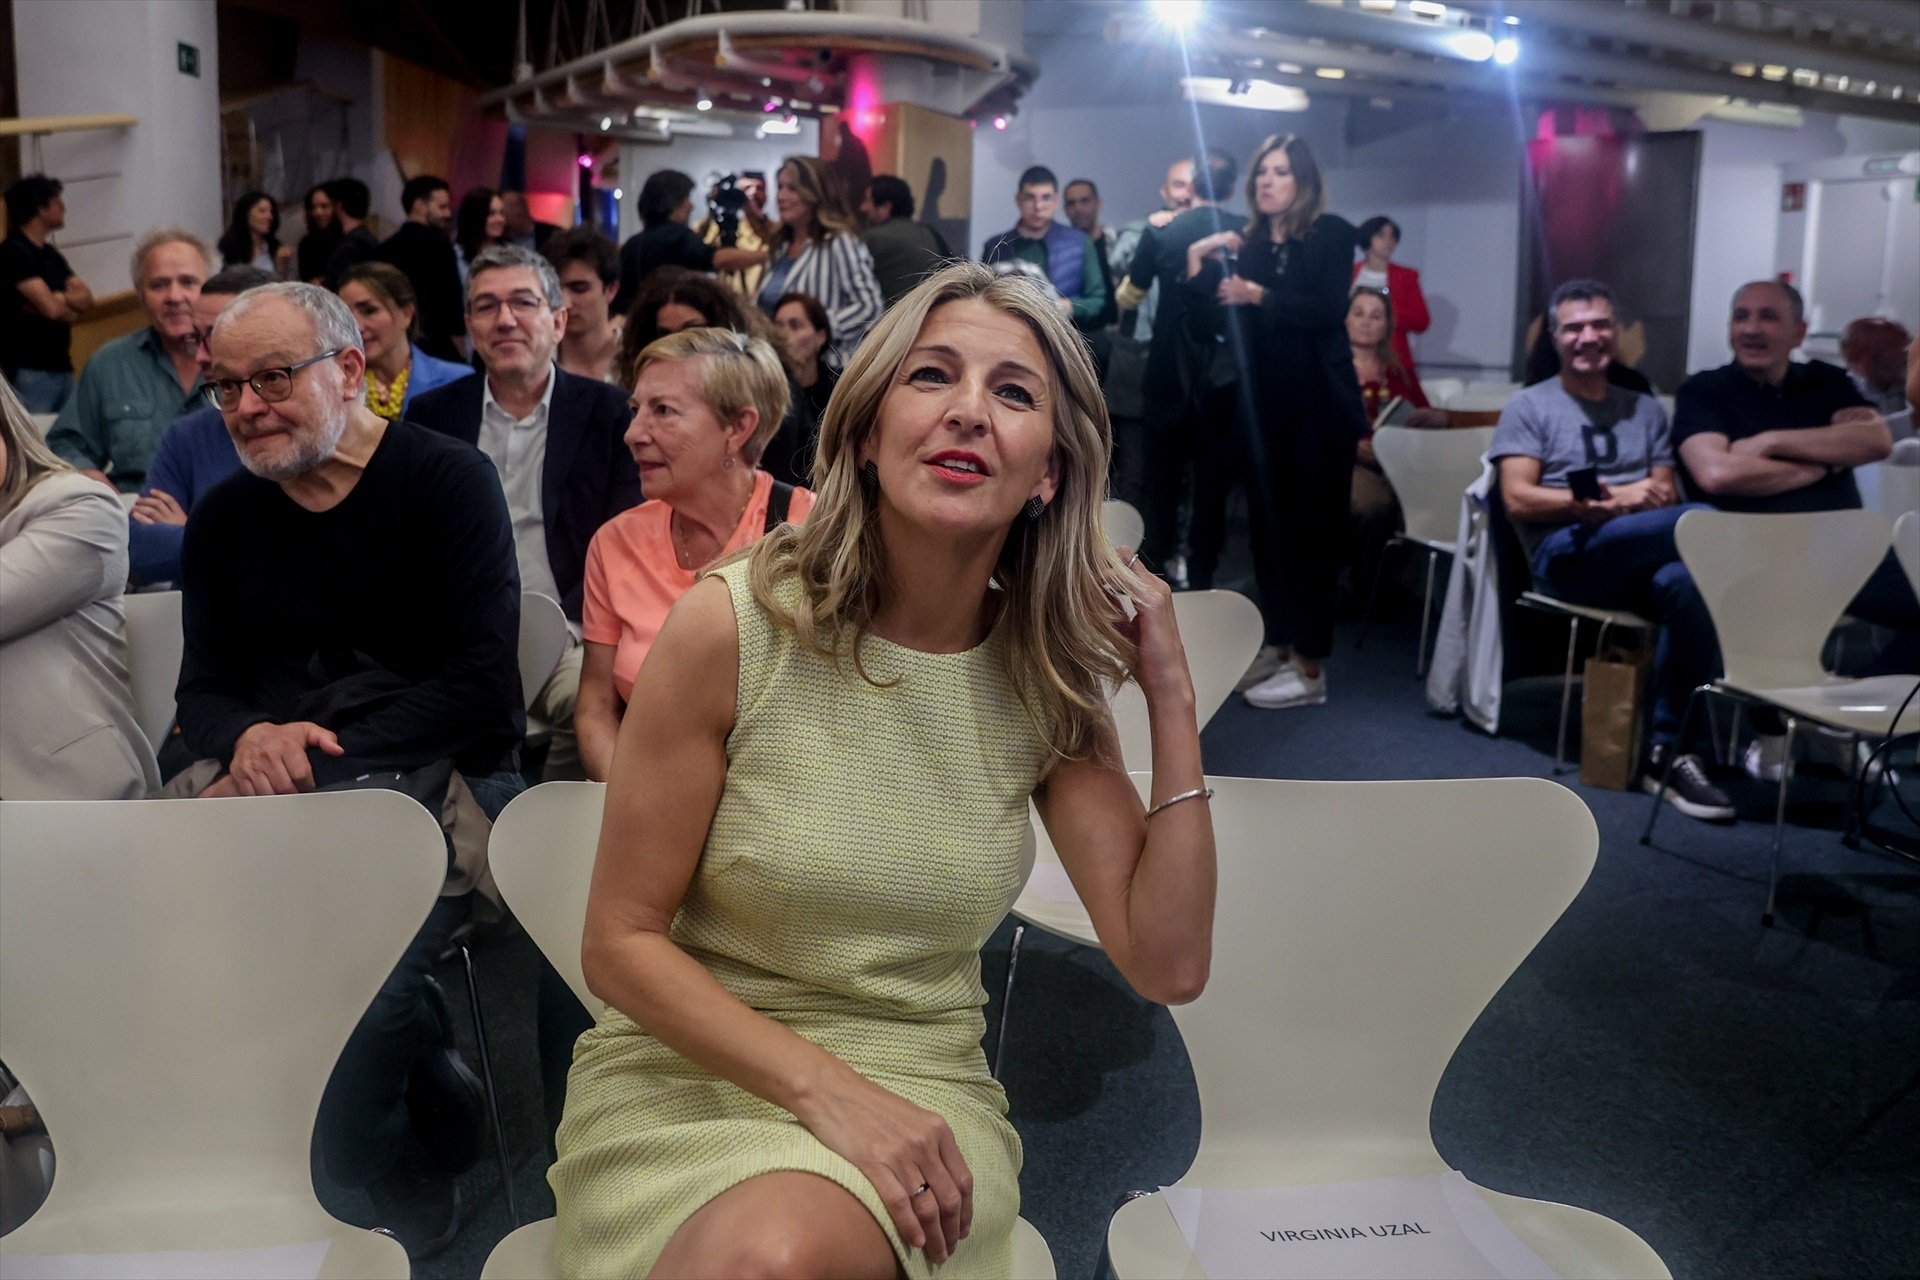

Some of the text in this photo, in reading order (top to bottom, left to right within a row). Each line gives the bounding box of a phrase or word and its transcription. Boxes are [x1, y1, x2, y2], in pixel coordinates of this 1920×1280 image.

[1581, 425, 1618, 464] D
[1260, 1222, 1431, 1242] VIRGINIA UZAL
